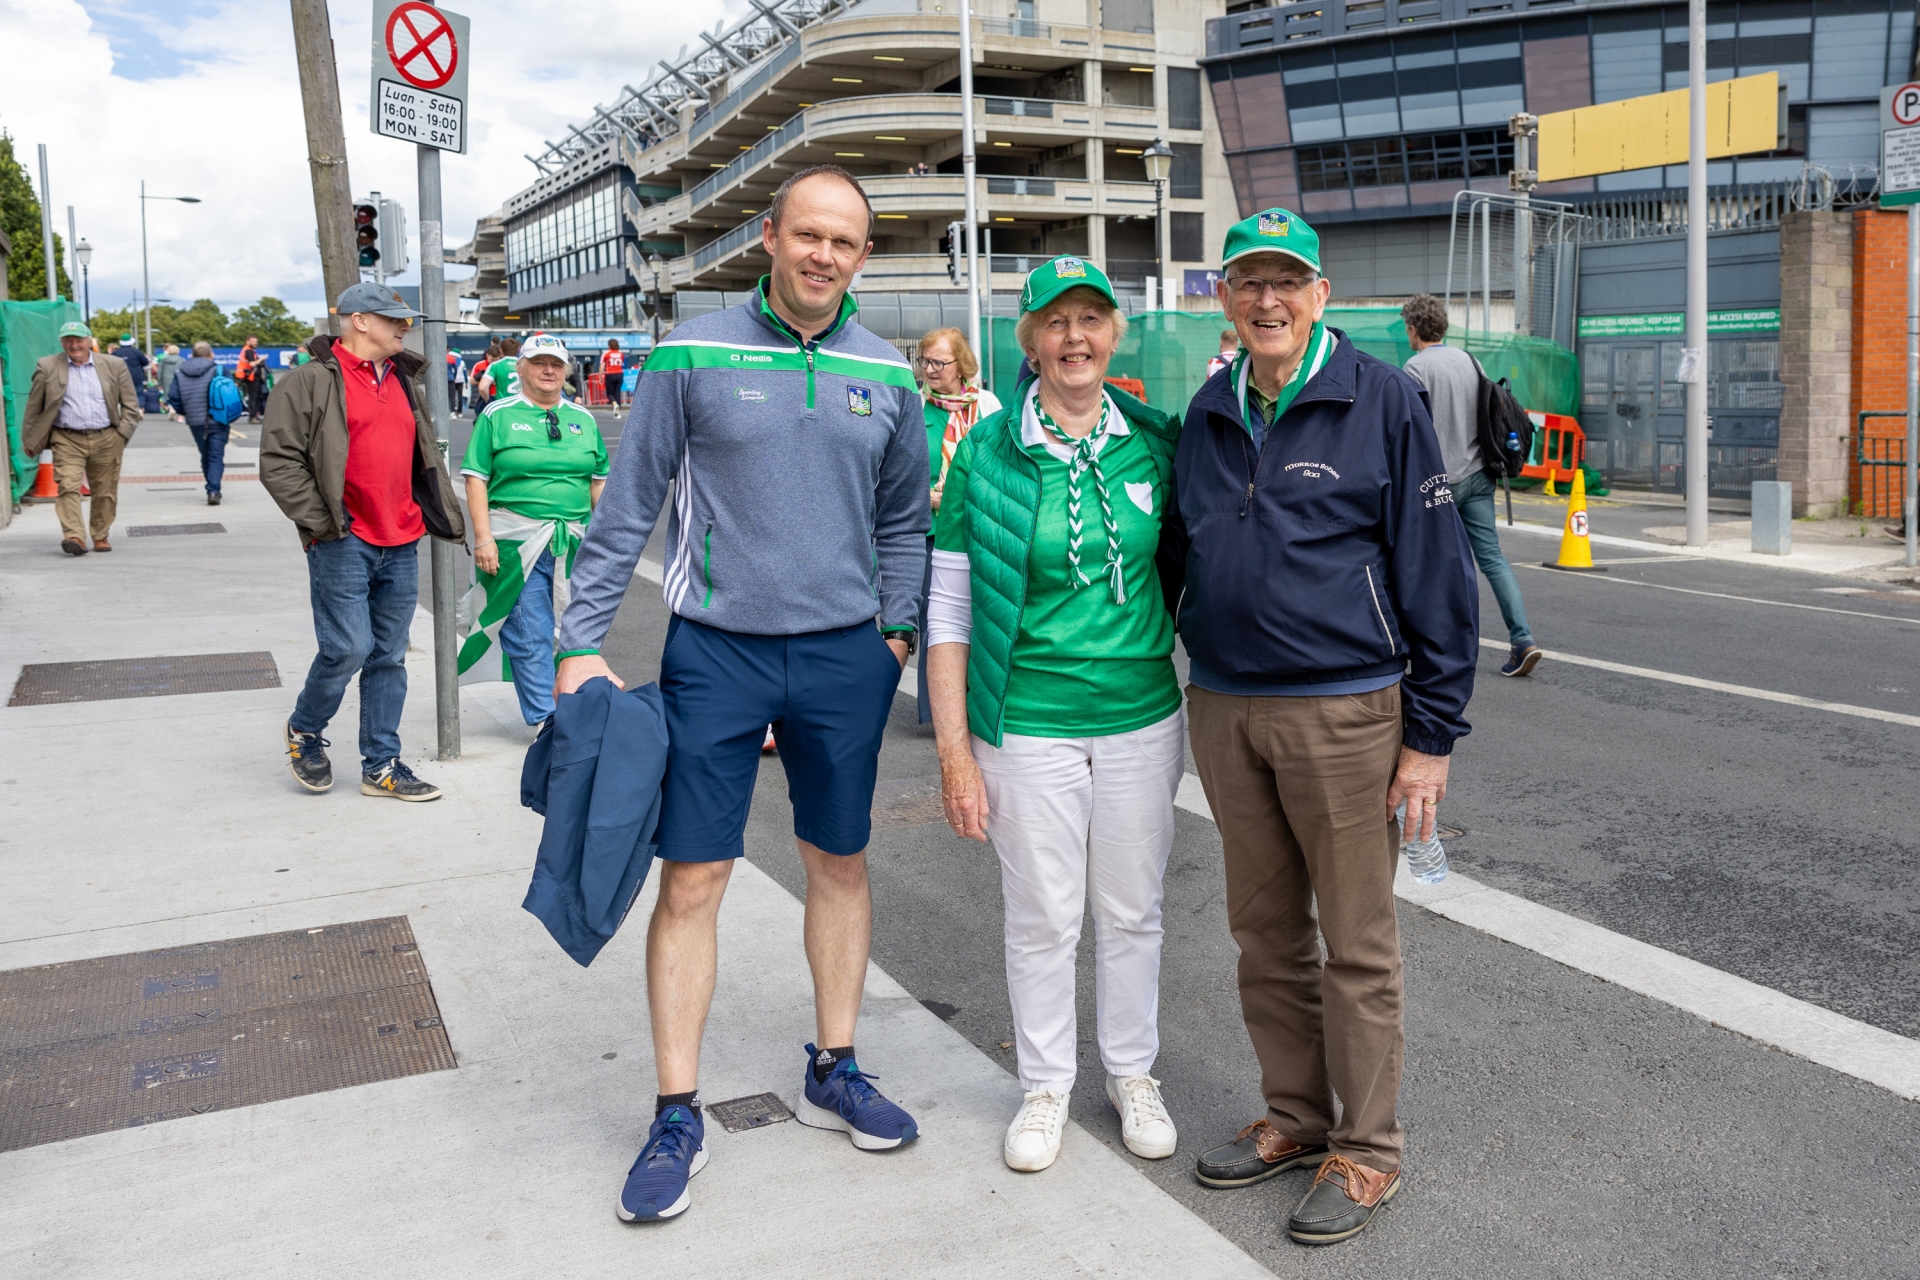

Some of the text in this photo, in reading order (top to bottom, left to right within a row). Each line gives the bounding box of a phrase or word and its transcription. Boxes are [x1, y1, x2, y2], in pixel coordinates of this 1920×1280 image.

[385, 86, 415, 104] Luan
[429, 98, 457, 115] Sath
[383, 102, 415, 120] 16:00
[427, 113, 457, 131] 19:00
[385, 119, 417, 137] MON
[430, 130, 454, 146] SAT
[1719, 313, 1742, 321] ACCESS
[1743, 311, 1776, 321] REQUIRED
[1425, 500, 1433, 509] &
